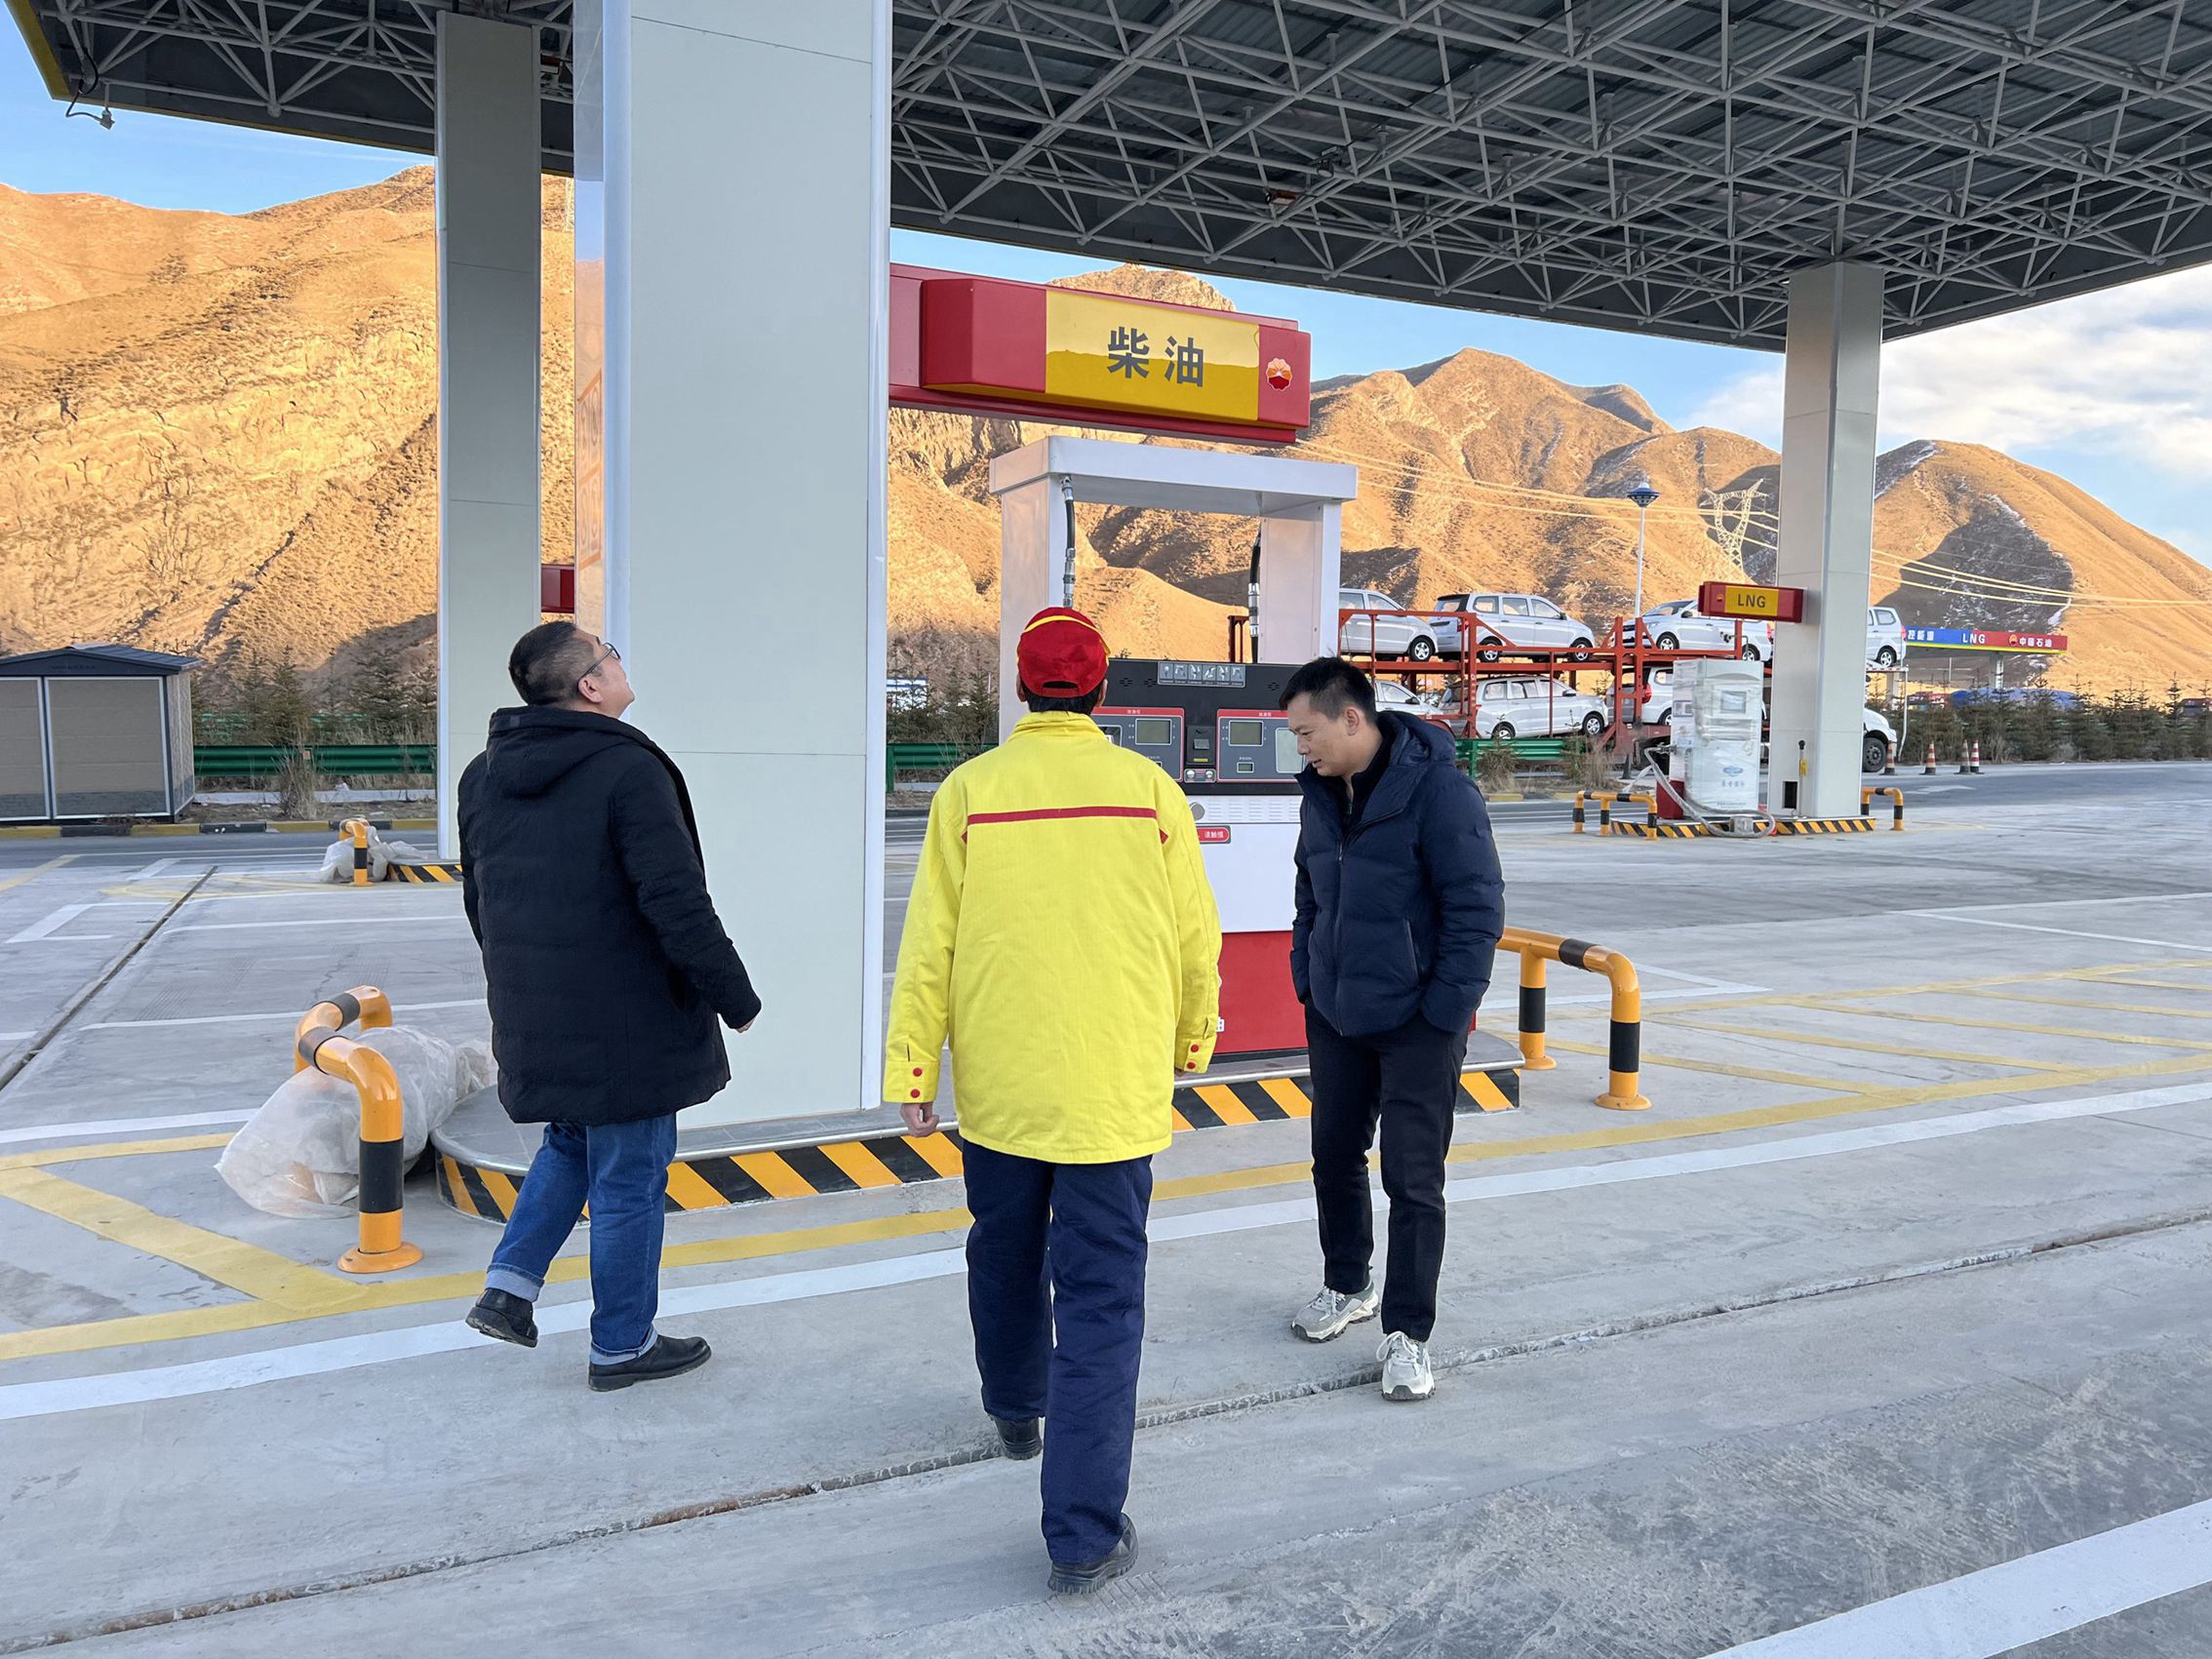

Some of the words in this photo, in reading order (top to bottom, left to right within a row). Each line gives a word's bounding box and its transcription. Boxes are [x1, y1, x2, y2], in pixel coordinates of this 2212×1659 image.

[1107, 327, 1205, 388] 柴油
[1737, 593, 1766, 609] LNG
[1962, 632, 1986, 644] LNG
[2019, 636, 2053, 648] 中国石油
